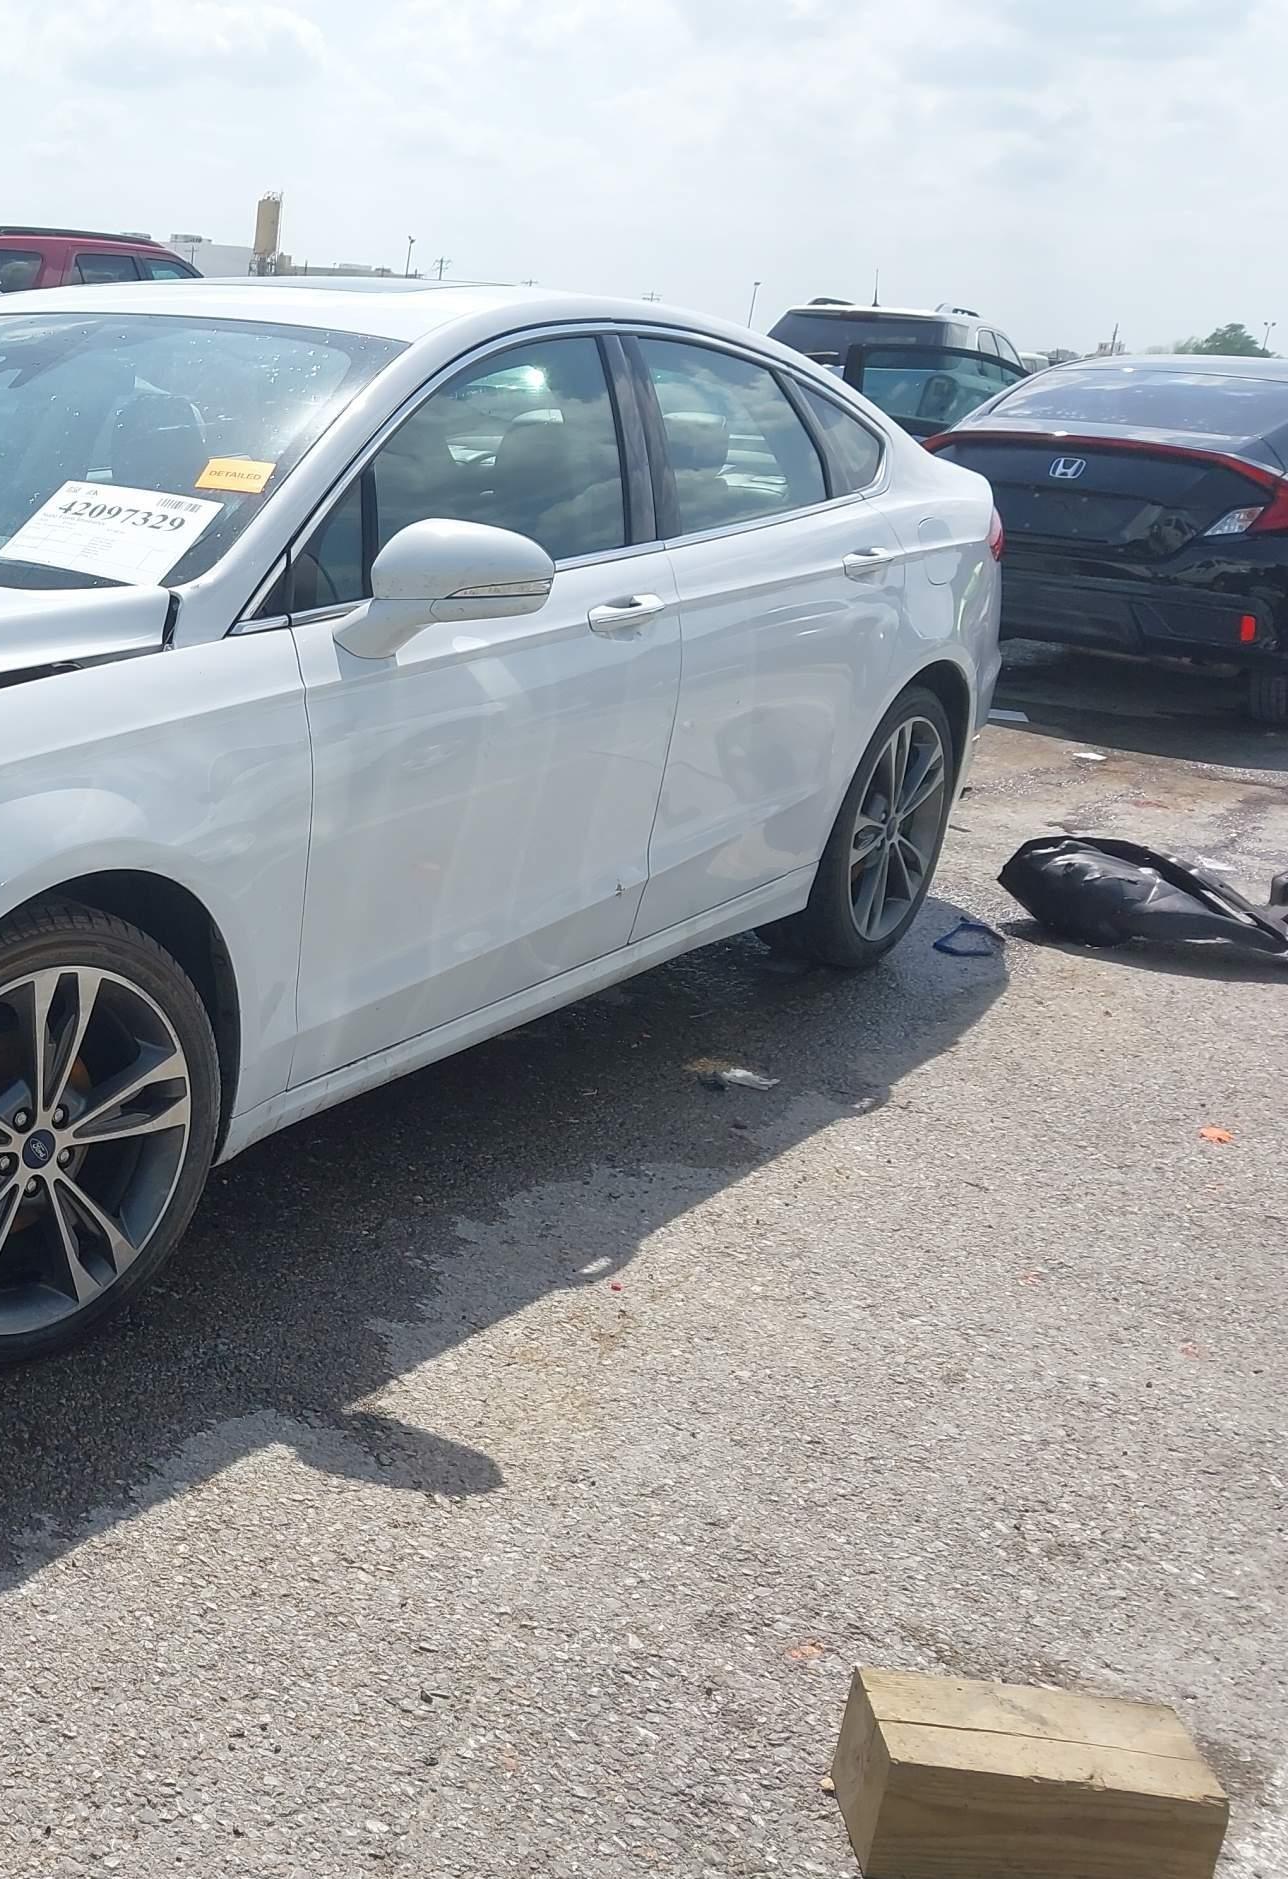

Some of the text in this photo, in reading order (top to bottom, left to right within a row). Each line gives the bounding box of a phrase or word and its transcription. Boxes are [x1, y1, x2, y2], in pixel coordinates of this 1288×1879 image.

[208, 470, 262, 481] DETAILED
[58, 500, 186, 532] 42097329
[31, 1140, 47, 1159] Ford
